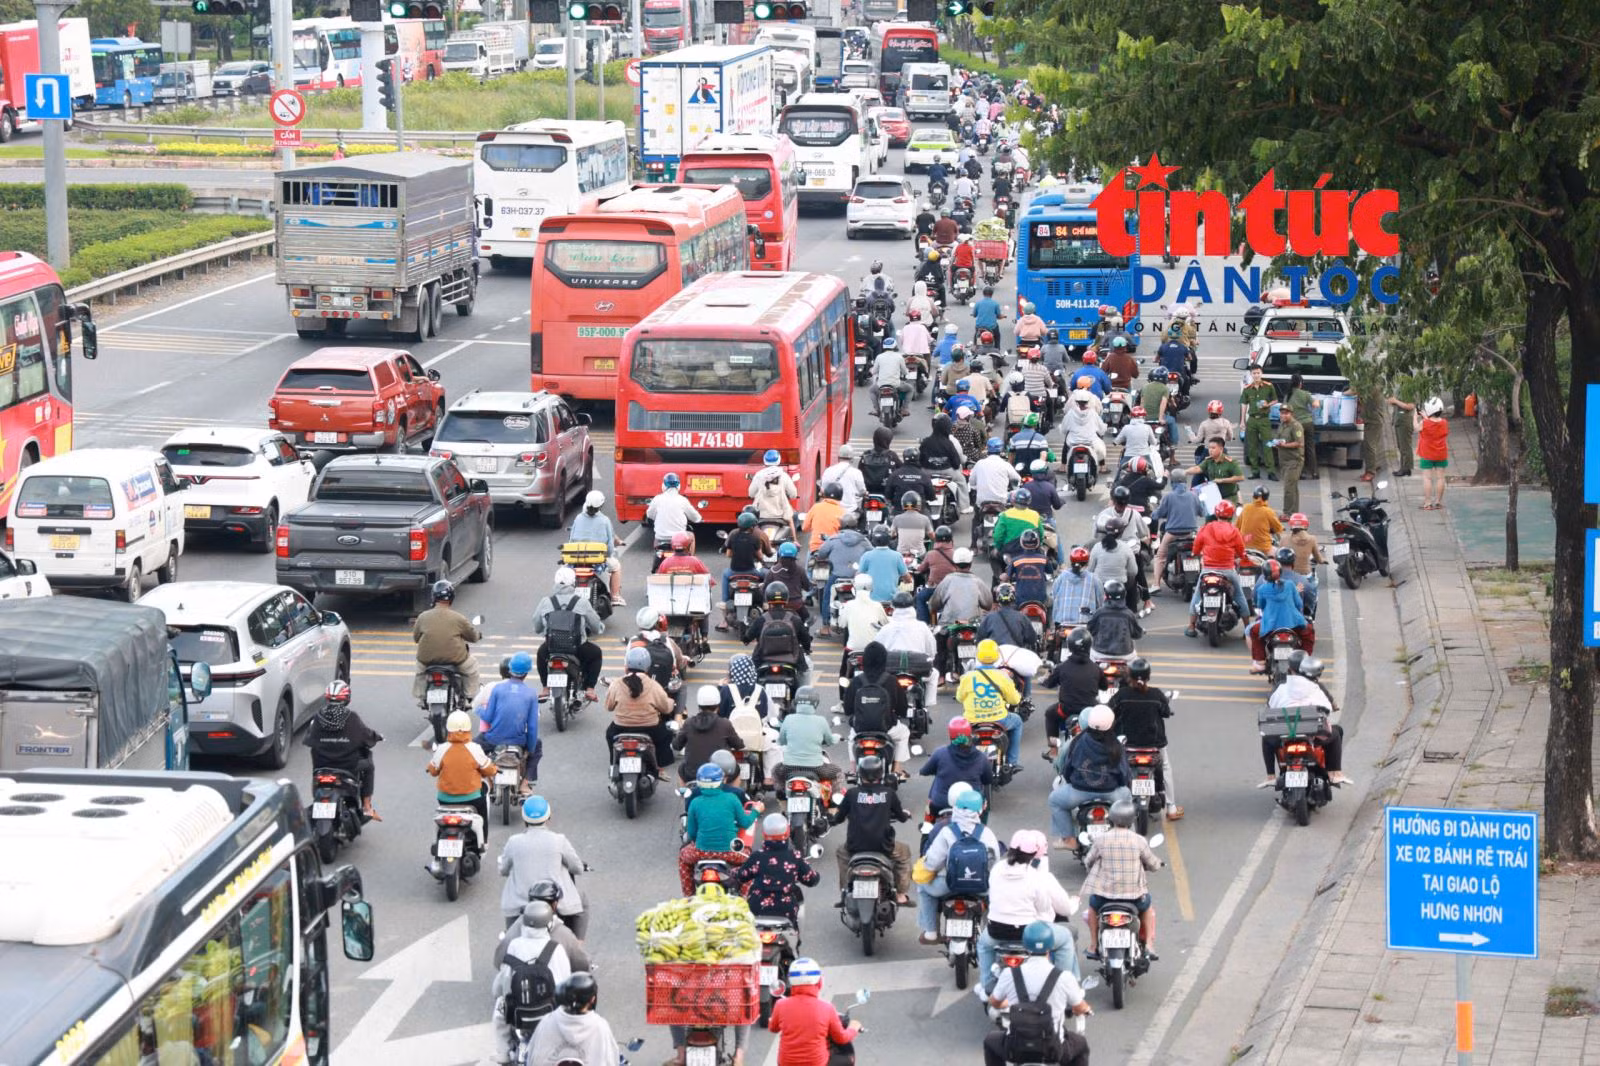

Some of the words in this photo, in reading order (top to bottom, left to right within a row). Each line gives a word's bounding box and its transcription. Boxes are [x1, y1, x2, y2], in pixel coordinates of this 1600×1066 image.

[1056, 227, 1067, 236] 84
[571, 278, 638, 286] UNIVERSE
[1055, 299, 1100, 309] 50H-411.82
[19, 745, 70, 753] FRONTIER
[1393, 813, 1440, 836] HƯỚNG
[1443, 820, 1457, 837] ĐI
[1461, 816, 1499, 839] DÀNH
[1503, 823, 1531, 840] CHO
[1395, 845, 1413, 862] XE
[1415, 846, 1431, 863] 02
[1434, 842, 1472, 865] BÁNH
[1497, 846, 1528, 868] TRÁI
[1422, 874, 1443, 896] TẠI
[1446, 876, 1478, 894] GIAO
[1481, 874, 1500, 900] LỘ
[1421, 902, 1460, 921] HƯNG
[1463, 904, 1503, 924] NHƠN
